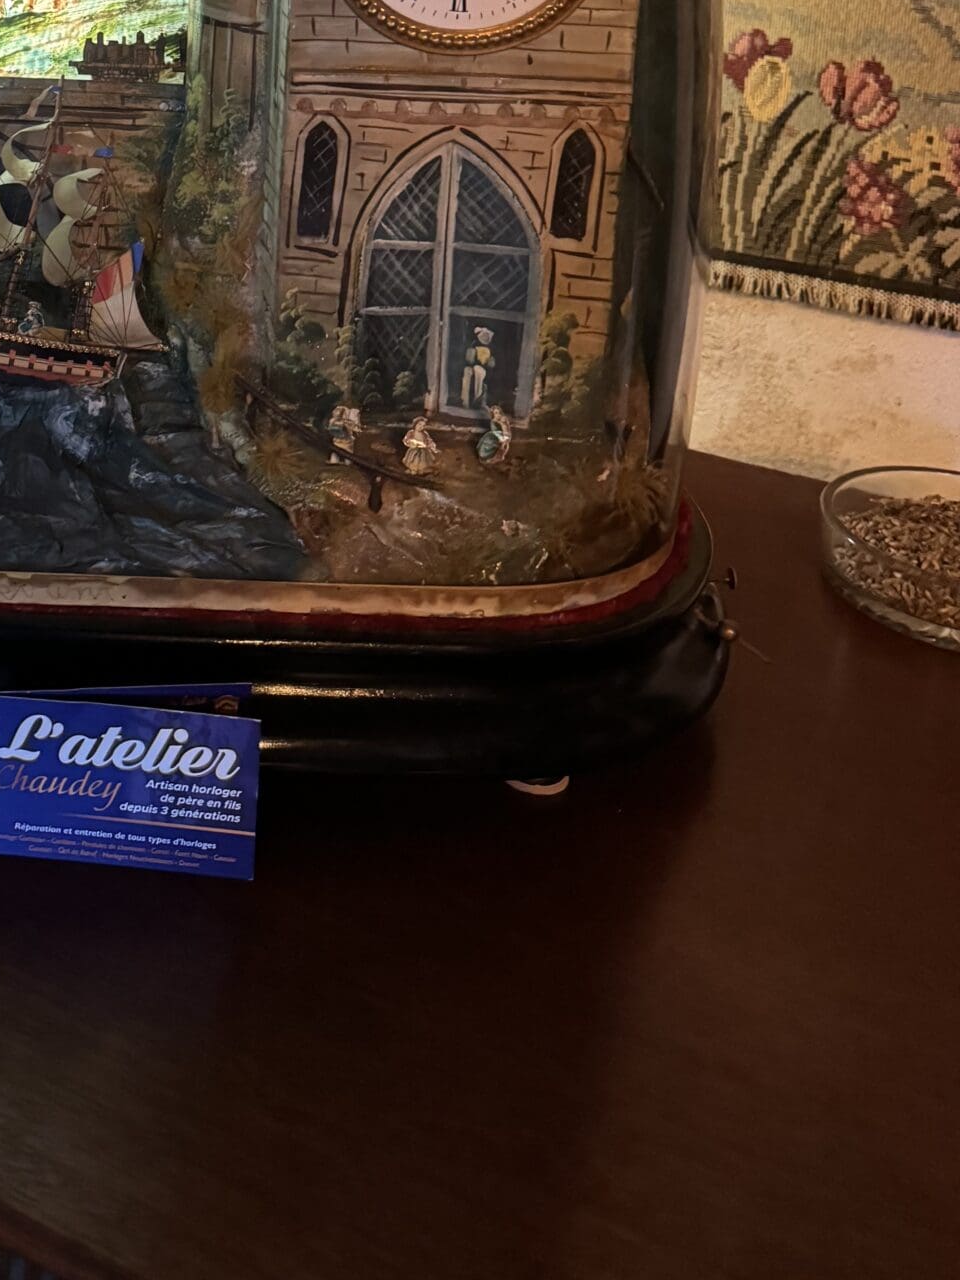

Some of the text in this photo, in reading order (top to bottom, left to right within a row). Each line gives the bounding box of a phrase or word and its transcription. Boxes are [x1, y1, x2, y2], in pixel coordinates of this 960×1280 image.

[145, 779, 243, 798] Artisan horloger
[160, 793, 242, 810] de père en fils
[119, 802, 241, 823] depuis 3 générations
[14, 822, 217, 850] Réparation et entretien de tous types d'horloges
